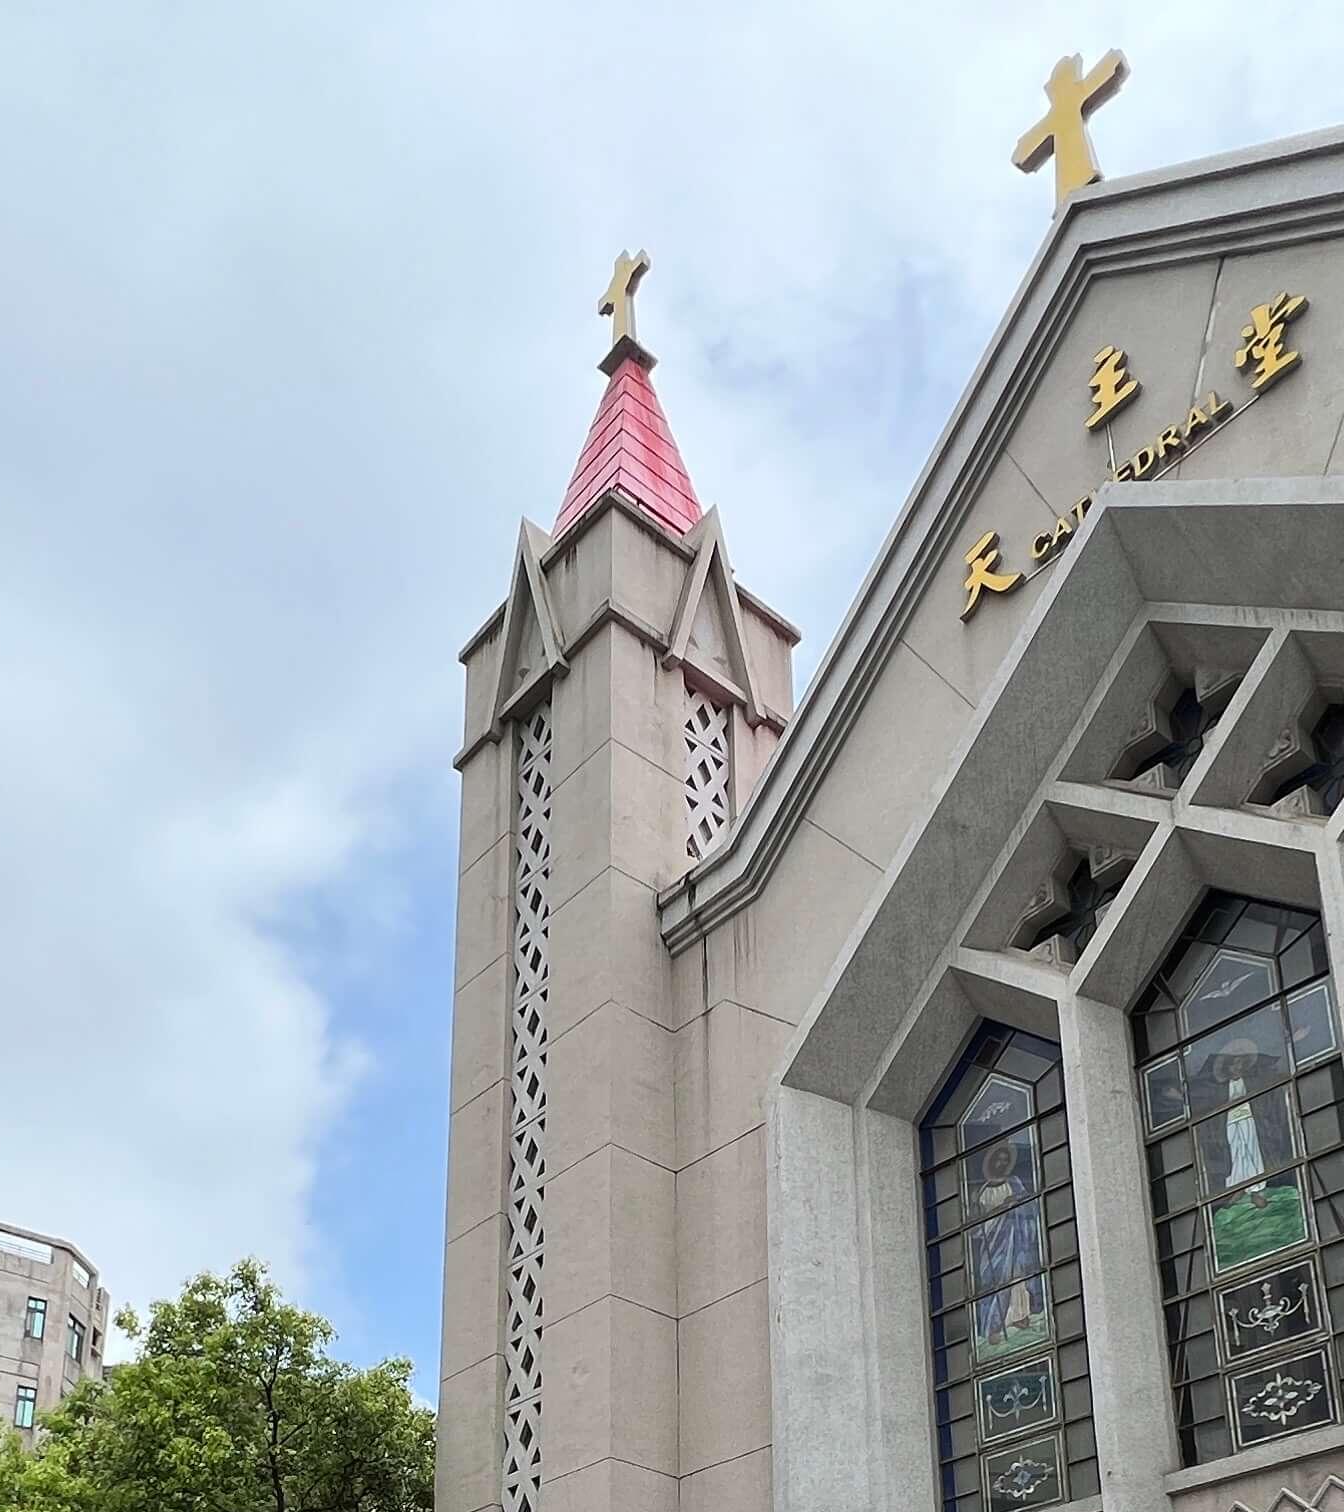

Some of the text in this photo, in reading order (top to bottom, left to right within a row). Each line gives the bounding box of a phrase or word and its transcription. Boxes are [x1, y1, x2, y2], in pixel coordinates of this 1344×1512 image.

[960, 291, 1310, 621] 天主堂
[1029, 391, 1234, 563] CATEDRAL
